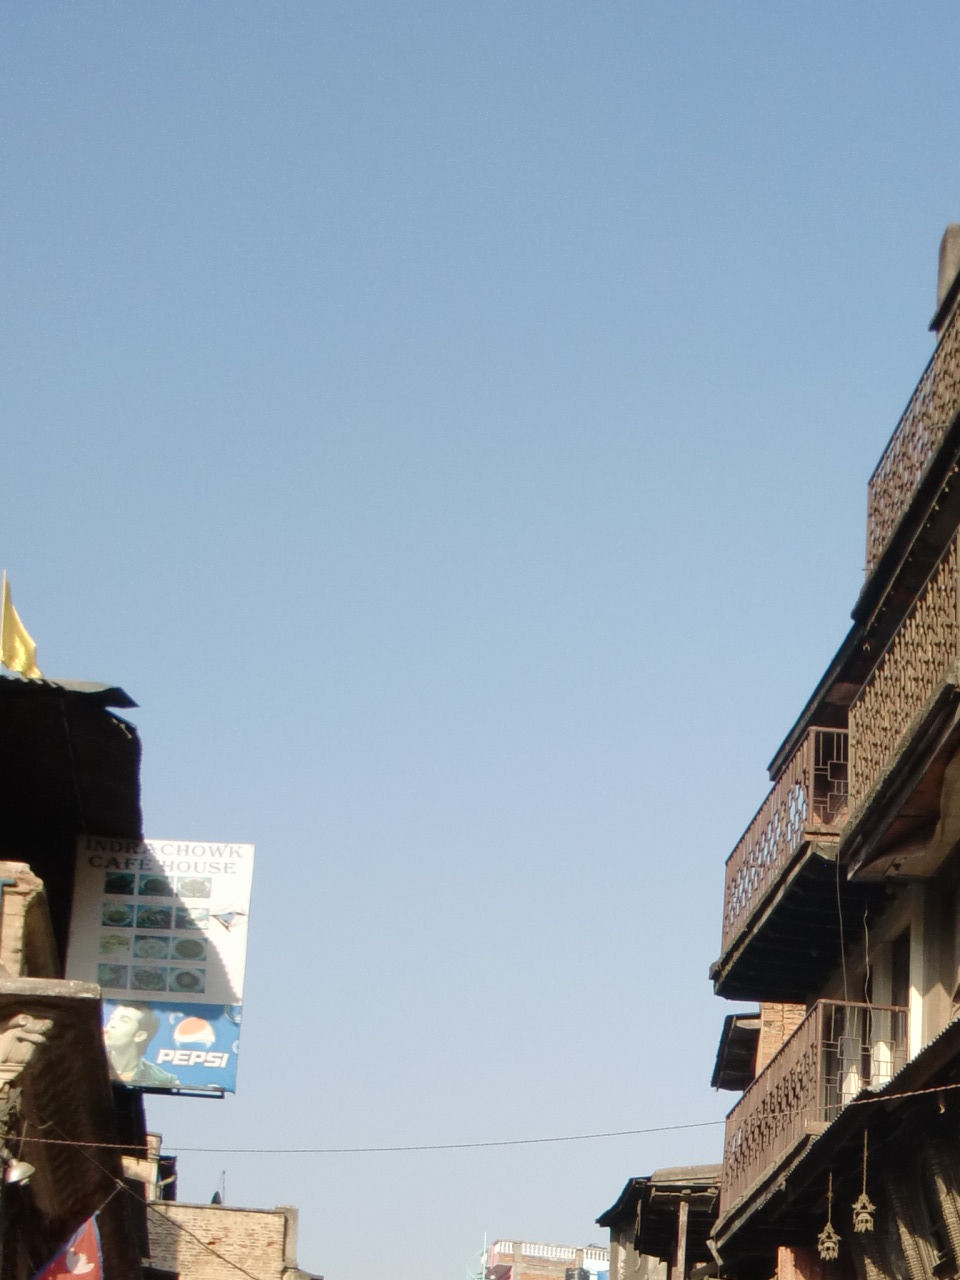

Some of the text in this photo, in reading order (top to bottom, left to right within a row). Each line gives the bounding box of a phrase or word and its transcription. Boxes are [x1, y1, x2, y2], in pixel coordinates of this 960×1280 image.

[86, 838, 243, 858] INDRACHOWK
[88, 855, 237, 875] CAFE HOUSE
[156, 1049, 229, 1069] PEPSI
